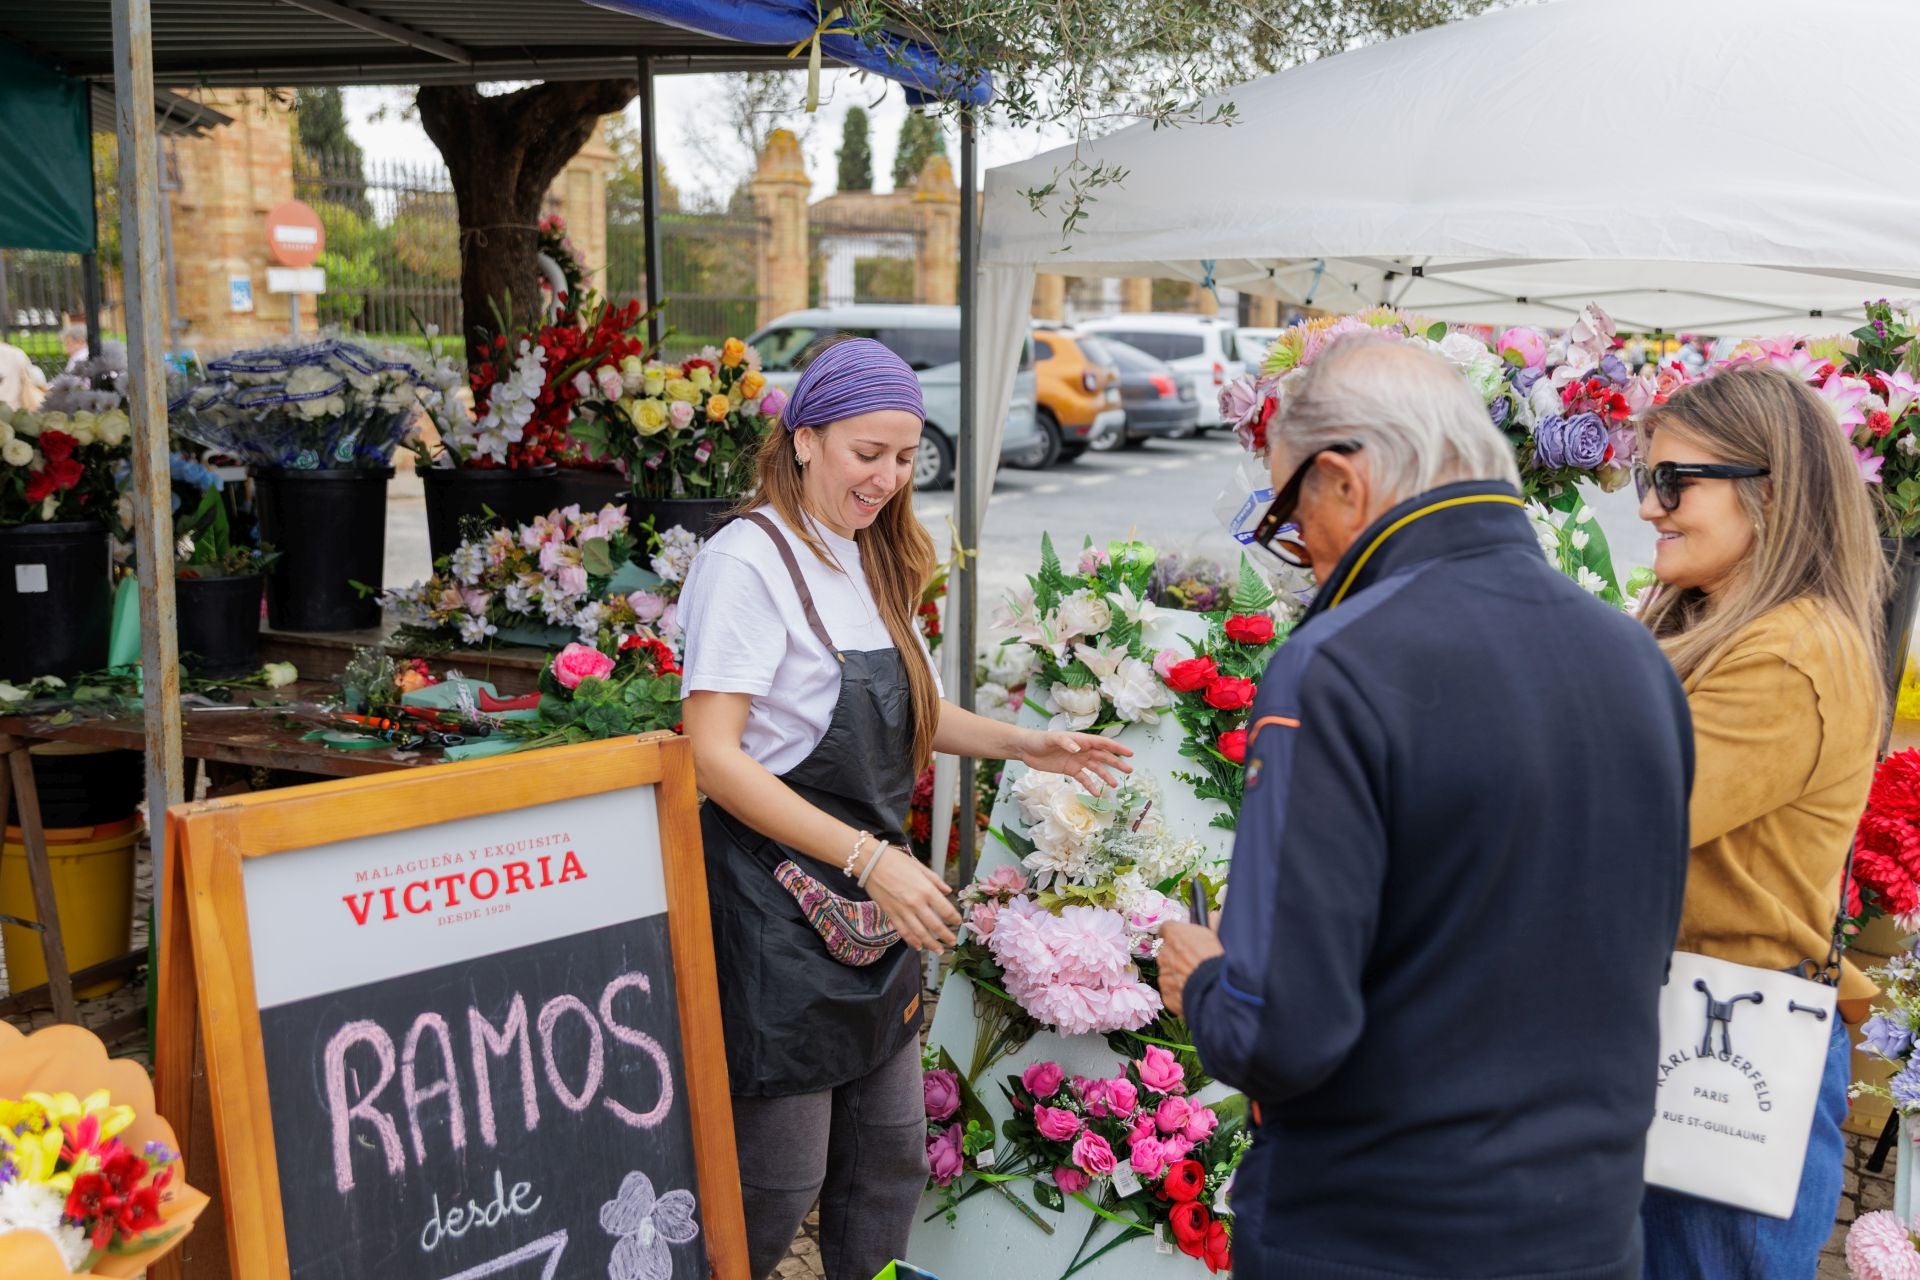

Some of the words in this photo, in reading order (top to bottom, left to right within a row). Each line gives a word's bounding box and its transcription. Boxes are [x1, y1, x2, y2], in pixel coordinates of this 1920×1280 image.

[355, 853, 463, 882] MALAGUEÑA
[469, 849, 479, 861] Y
[484, 832, 571, 857] EXQUISITA
[342, 850, 588, 927] VICTORIA
[437, 908, 481, 926] DESDE
[485, 902, 512, 917] 1928
[324, 971, 673, 1193] RAMOS
[1693, 1087, 1729, 1104] PARIS
[1662, 1111, 1683, 1124] RUE
[1687, 1117, 1767, 1144] ST-GUILLAUME
[420, 1169, 542, 1251] desde
